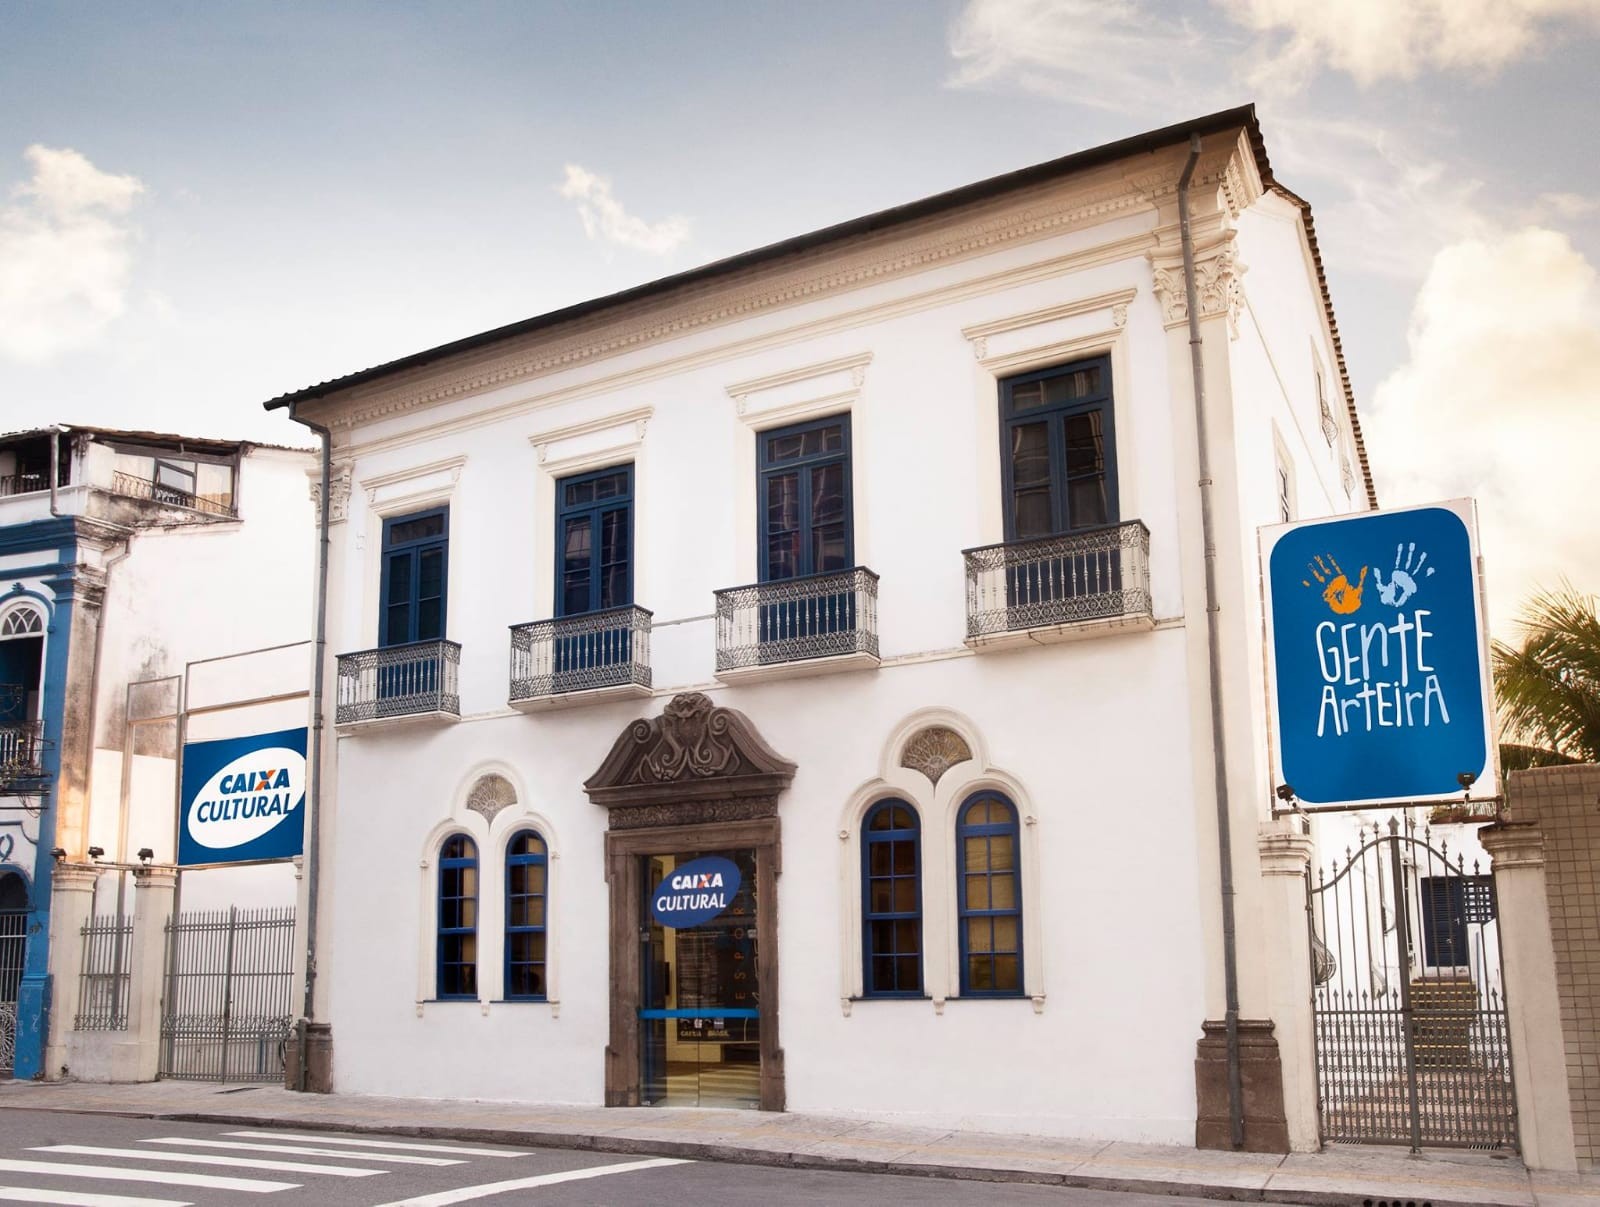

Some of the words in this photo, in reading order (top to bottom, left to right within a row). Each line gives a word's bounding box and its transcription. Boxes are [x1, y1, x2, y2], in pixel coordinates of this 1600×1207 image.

[219, 768, 290, 795] CAIXA
[197, 793, 294, 823] CULTURAL
[671, 872, 724, 890] CAIXA
[656, 892, 727, 912] CULTURAL
